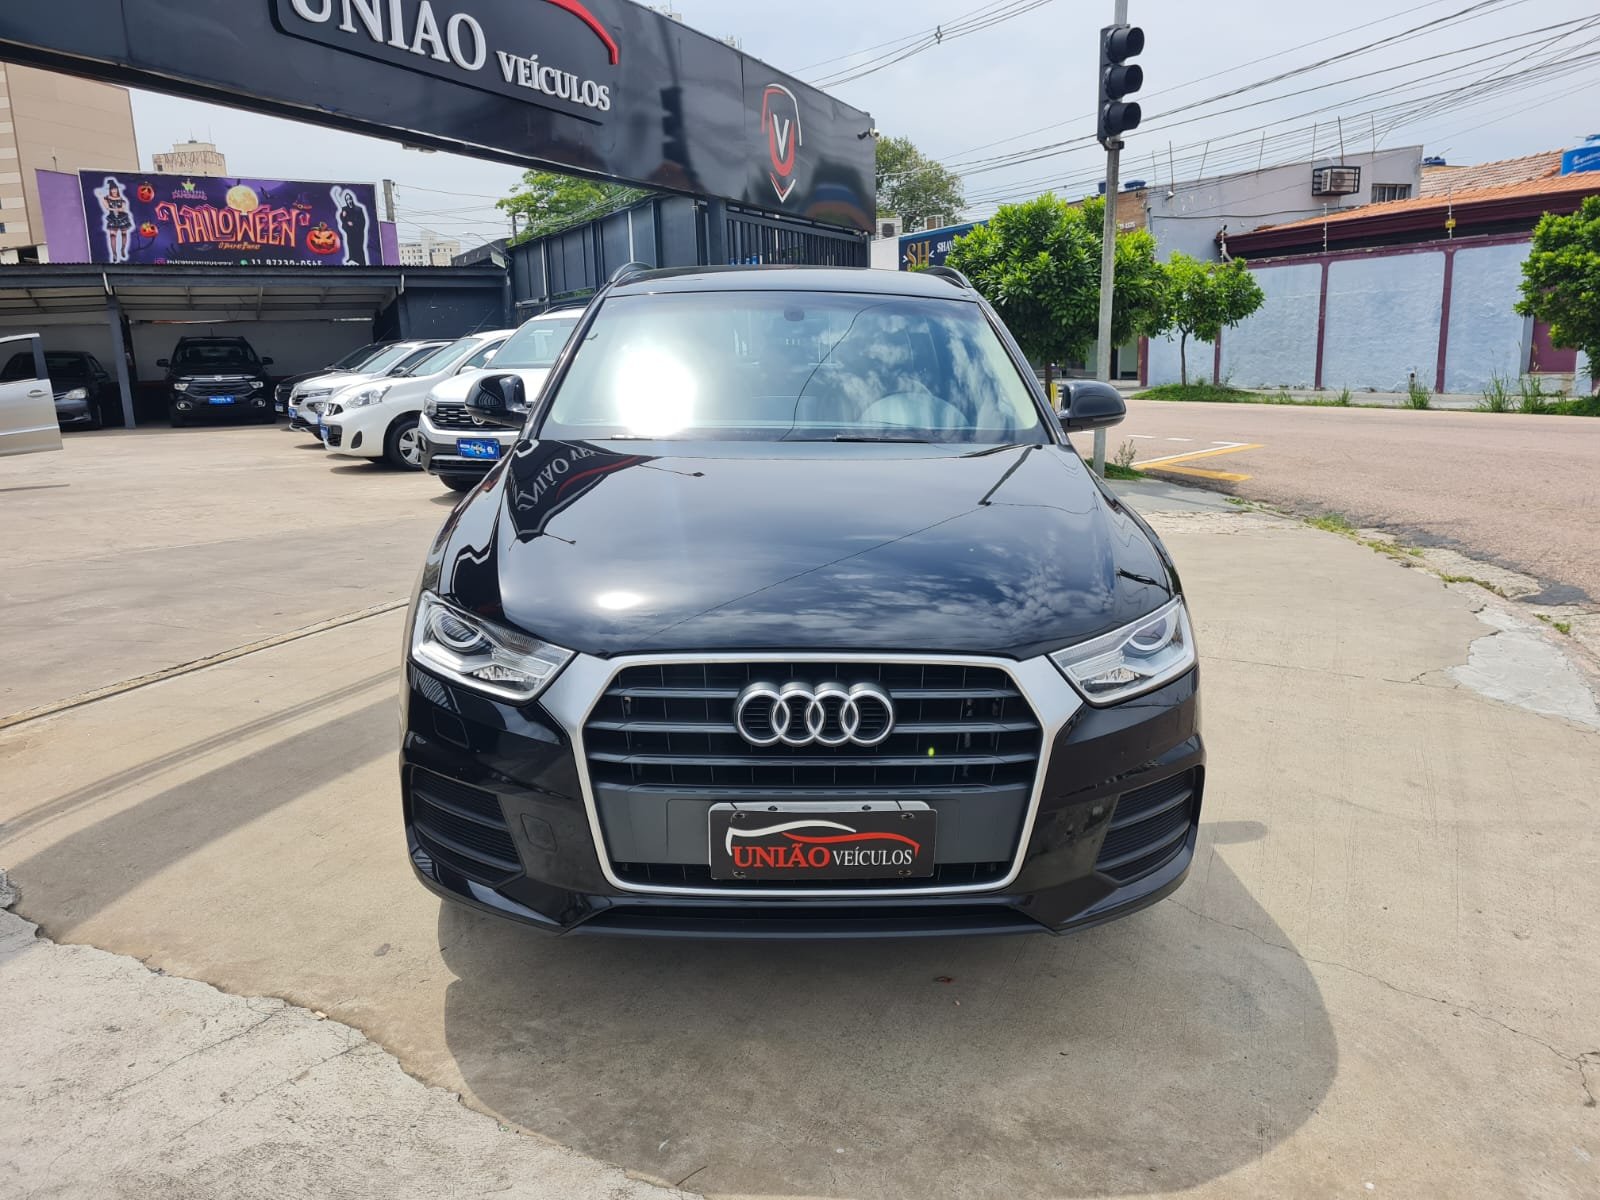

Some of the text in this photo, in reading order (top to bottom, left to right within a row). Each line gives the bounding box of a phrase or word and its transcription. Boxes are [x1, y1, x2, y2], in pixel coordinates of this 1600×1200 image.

[496, 50, 611, 111] VEÍCULOS
[155, 201, 311, 248] HALLOWEEN
[731, 843, 913, 868] UNIÃO VEÍCULOS
